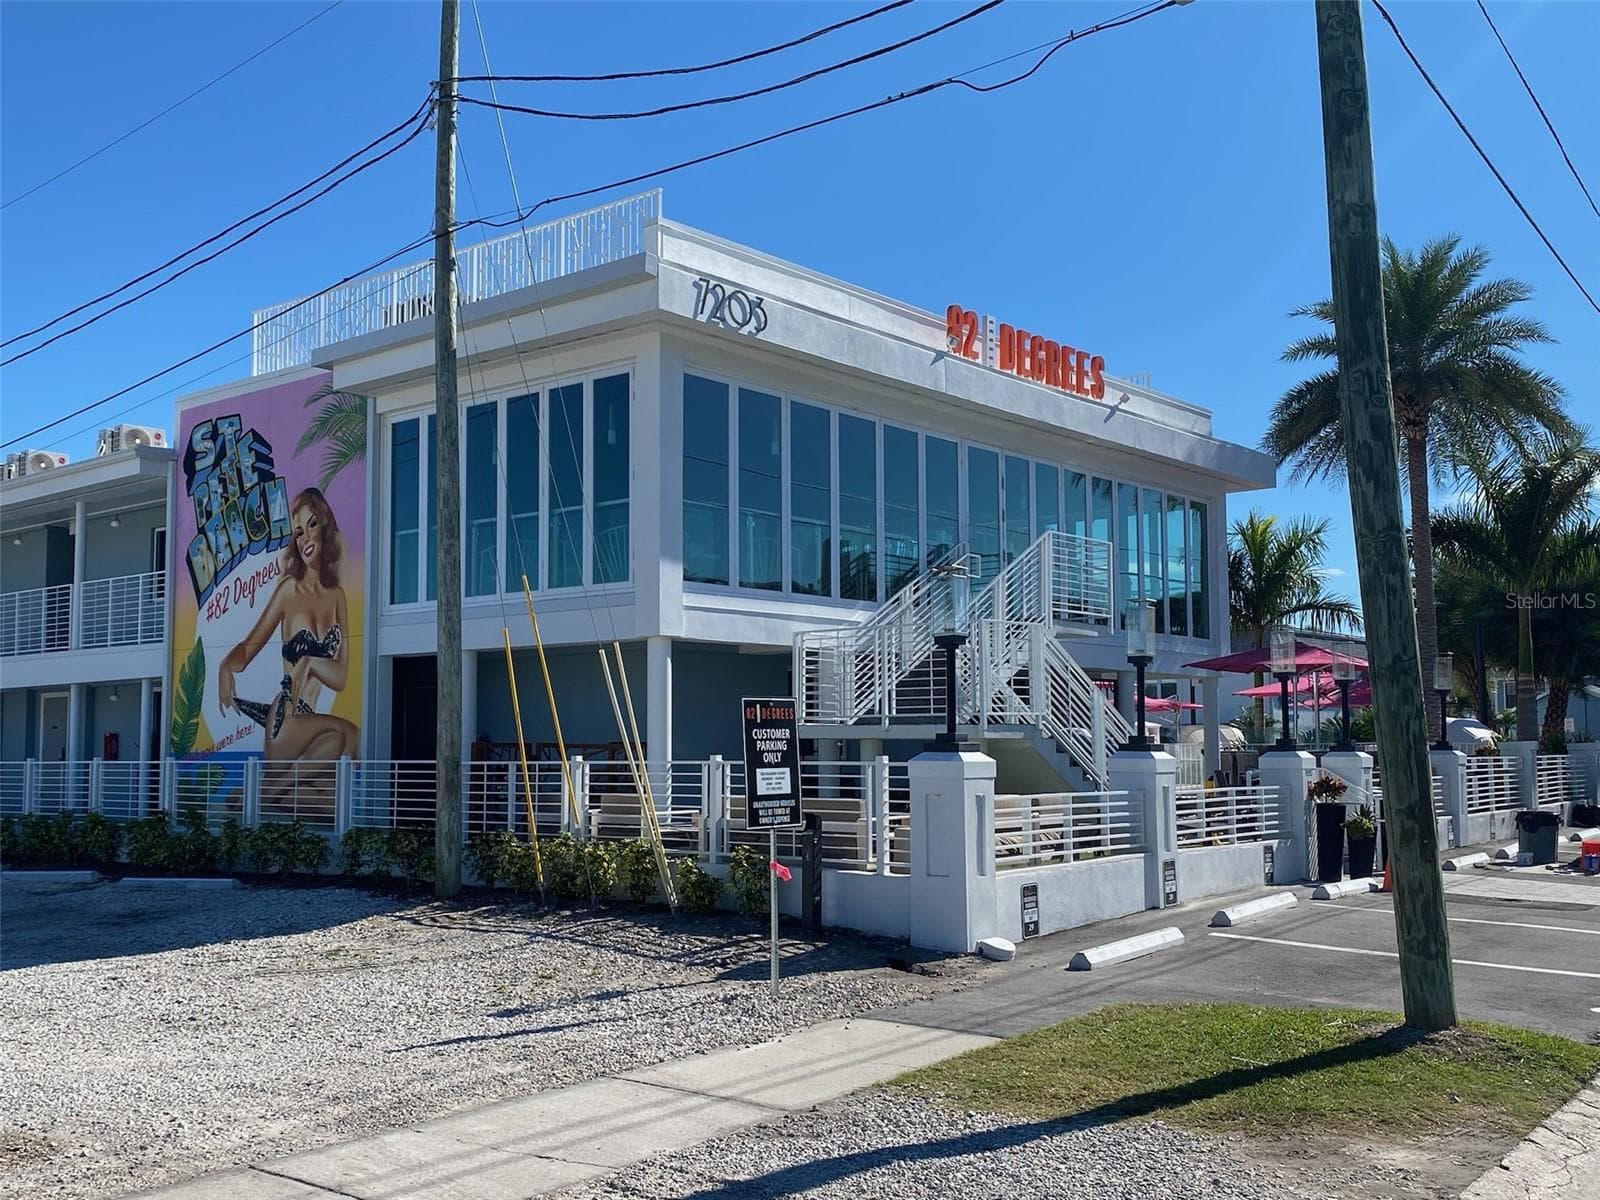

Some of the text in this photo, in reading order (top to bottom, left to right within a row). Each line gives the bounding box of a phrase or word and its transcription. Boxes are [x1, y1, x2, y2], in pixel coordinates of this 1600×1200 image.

[946, 304, 1105, 401] 82 DEGREES
[189, 414, 242, 472] ST
[193, 429, 262, 529] PETE
[187, 477, 292, 596] BEACH
[206, 557, 281, 622] #82 Degrees
[745, 707, 794, 720] 82 DEGREES
[752, 728, 791, 739] CUSTOMER
[756, 740, 787, 751] PARKING
[763, 752, 782, 763] ONLY
